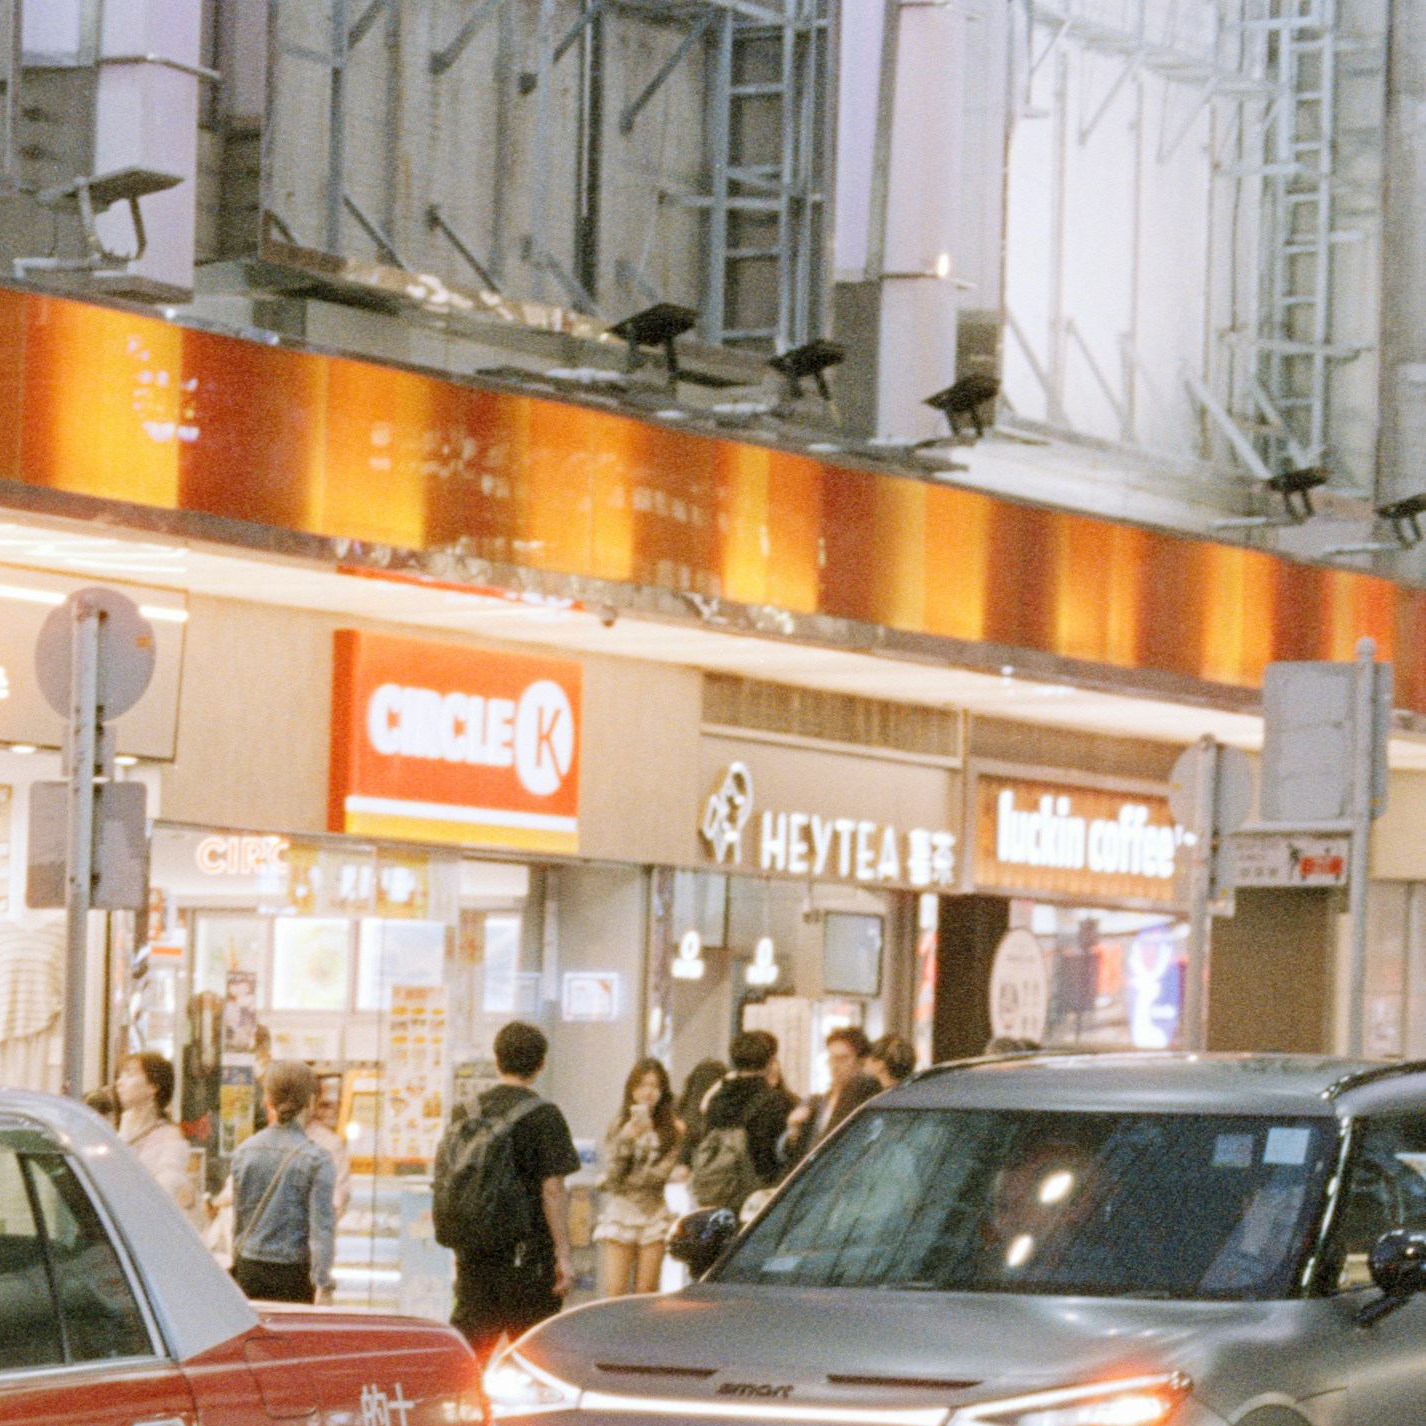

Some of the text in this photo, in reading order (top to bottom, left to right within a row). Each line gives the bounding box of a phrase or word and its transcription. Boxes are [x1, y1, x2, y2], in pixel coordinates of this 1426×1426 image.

[368, 684, 514, 765] CIRCLE
[761, 811, 900, 881] HEYTEA
[997, 788, 1084, 869] luckin
